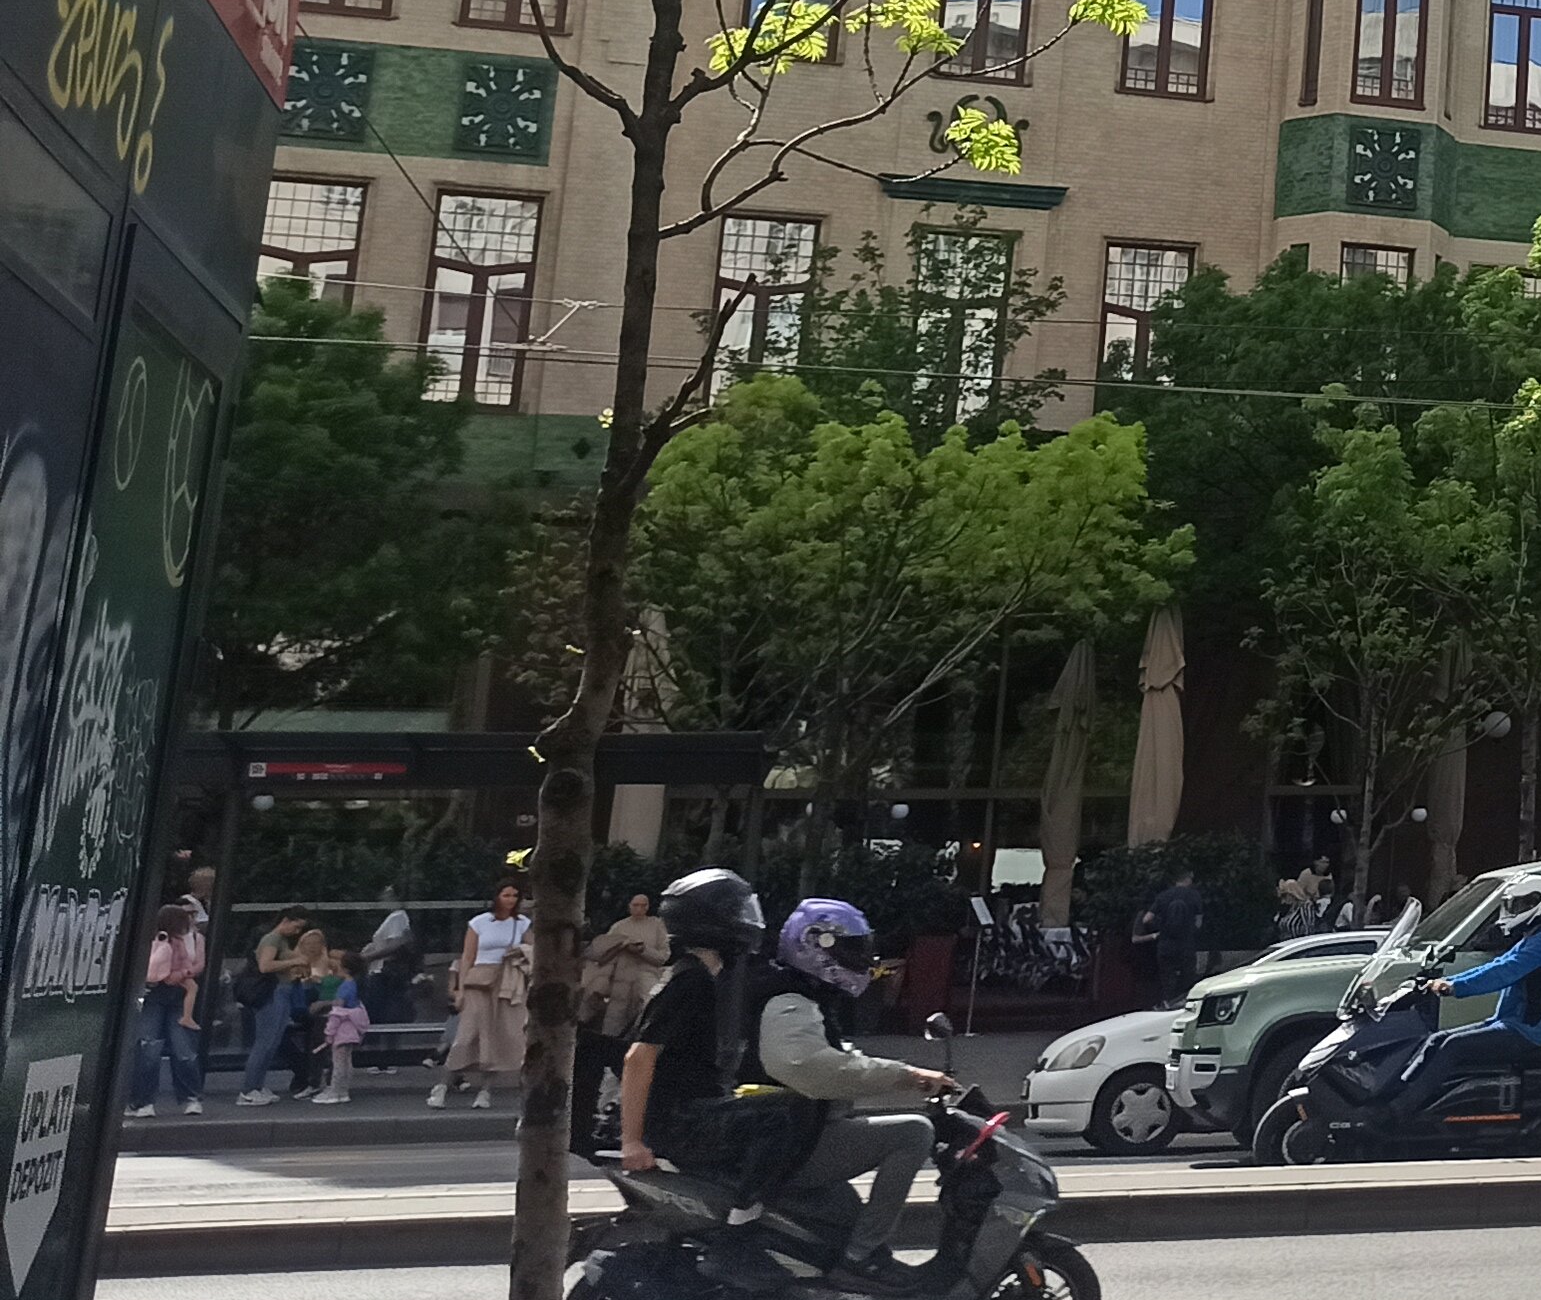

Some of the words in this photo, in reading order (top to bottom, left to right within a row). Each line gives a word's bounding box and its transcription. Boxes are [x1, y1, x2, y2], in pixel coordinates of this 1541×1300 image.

[22, 884, 128, 1002] MAXBET
[21, 1084, 73, 1143] UPLATI
[10, 1150, 62, 1203] DEPOZIT
